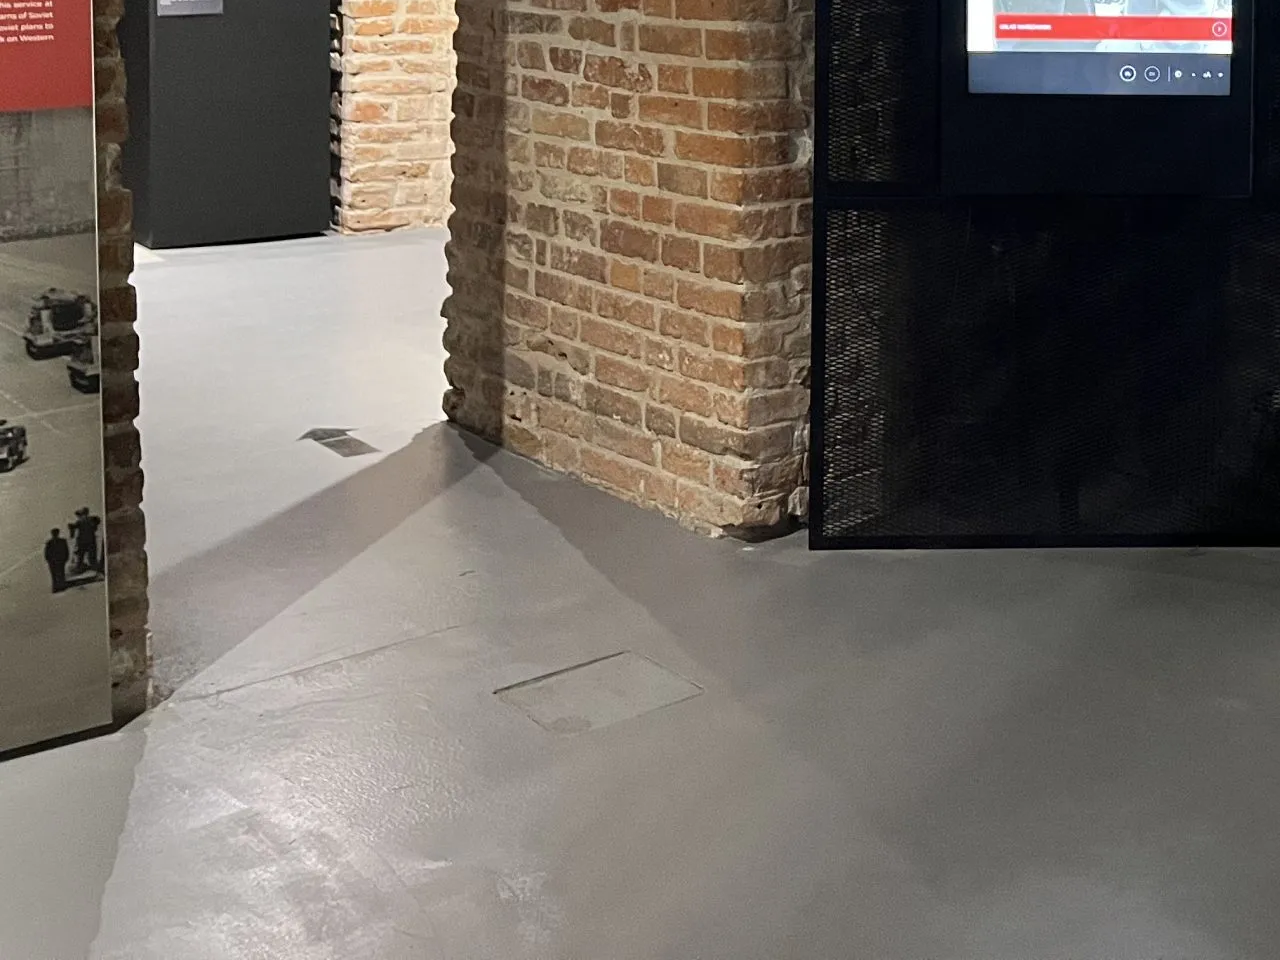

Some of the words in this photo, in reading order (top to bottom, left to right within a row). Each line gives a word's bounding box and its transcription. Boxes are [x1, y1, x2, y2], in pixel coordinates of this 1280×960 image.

[18, 11, 28, 20] of
[28, 11, 54, 20] Soviet
[20, 23, 44, 32] plans
